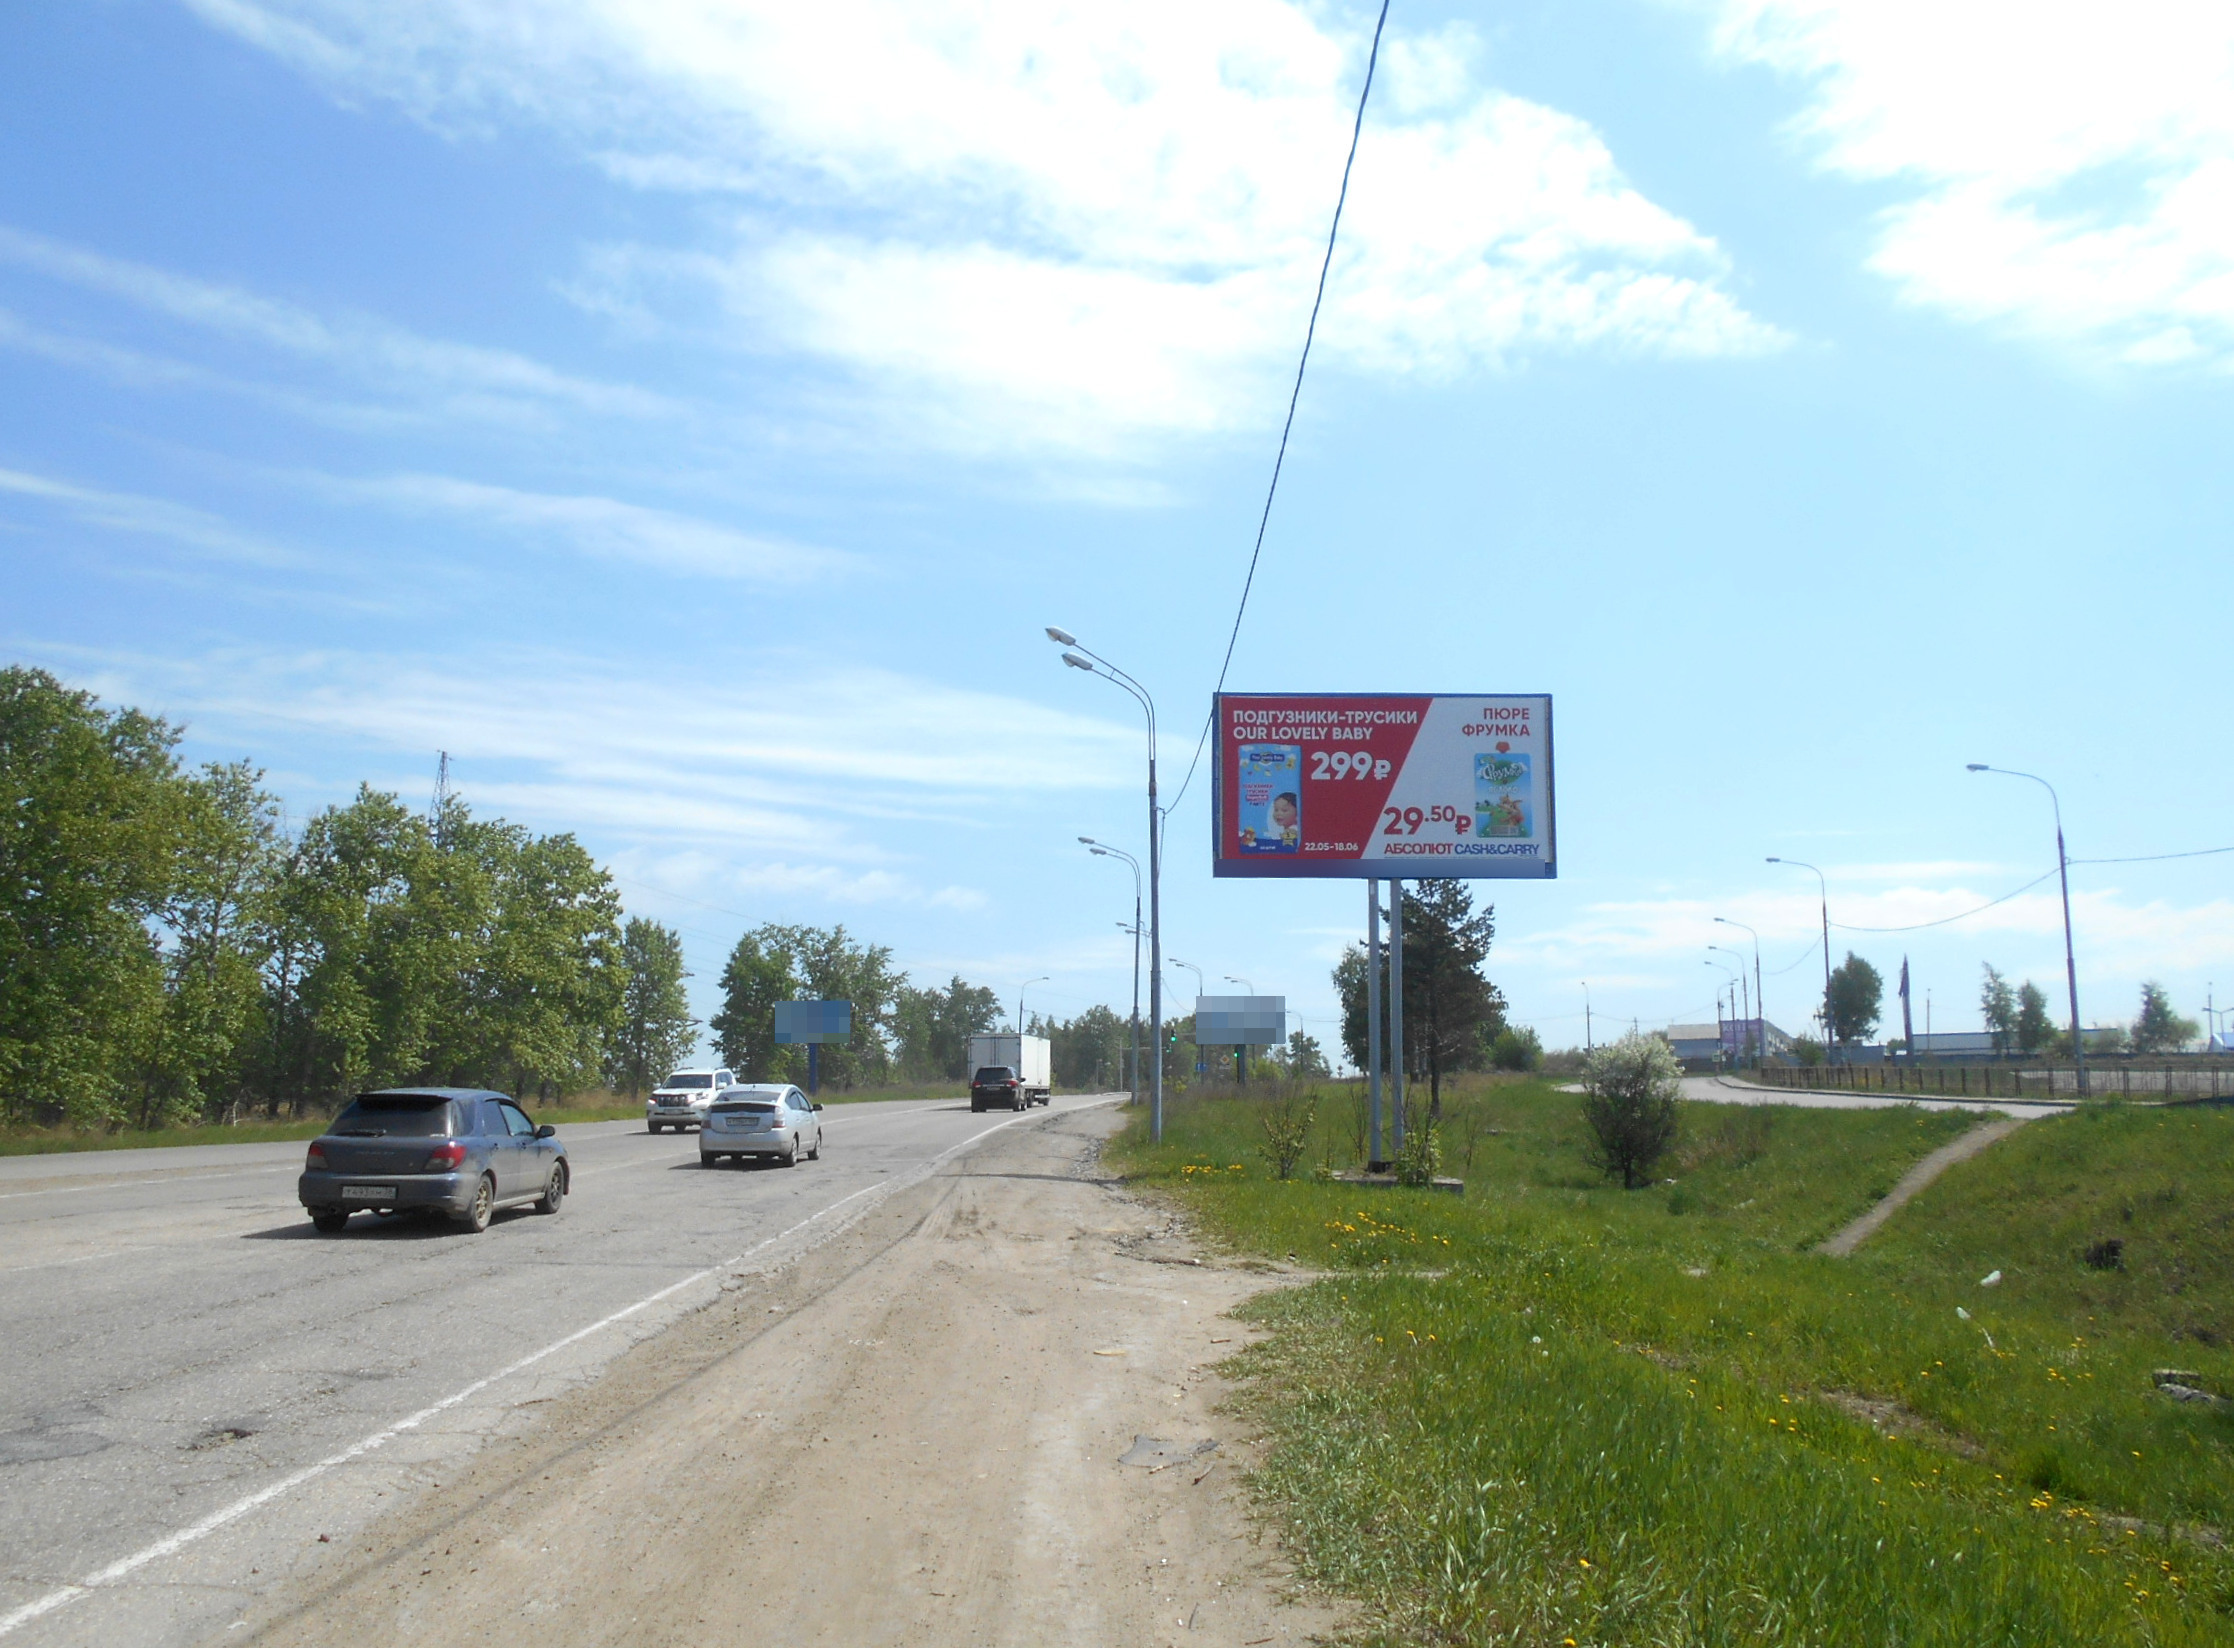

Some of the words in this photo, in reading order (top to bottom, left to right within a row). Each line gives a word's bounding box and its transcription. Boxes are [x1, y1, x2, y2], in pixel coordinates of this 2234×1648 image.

[1233, 710, 1418, 725] ПОДГУЗНИКИ-ТРУСИКИ
[1483, 707, 1530, 721] ПЮРЕ
[1233, 726, 1268, 740] OUR
[1271, 726, 1328, 740] LOVELY
[1332, 727, 1373, 741] BABY
[1461, 724, 1531, 737] ФРУМКА
[1304, 842, 1359, 851] 22.05-18.06
[1383, 843, 1453, 855] АБСОЛЮТ
[1453, 843, 1540, 856] CASH&CARRY
